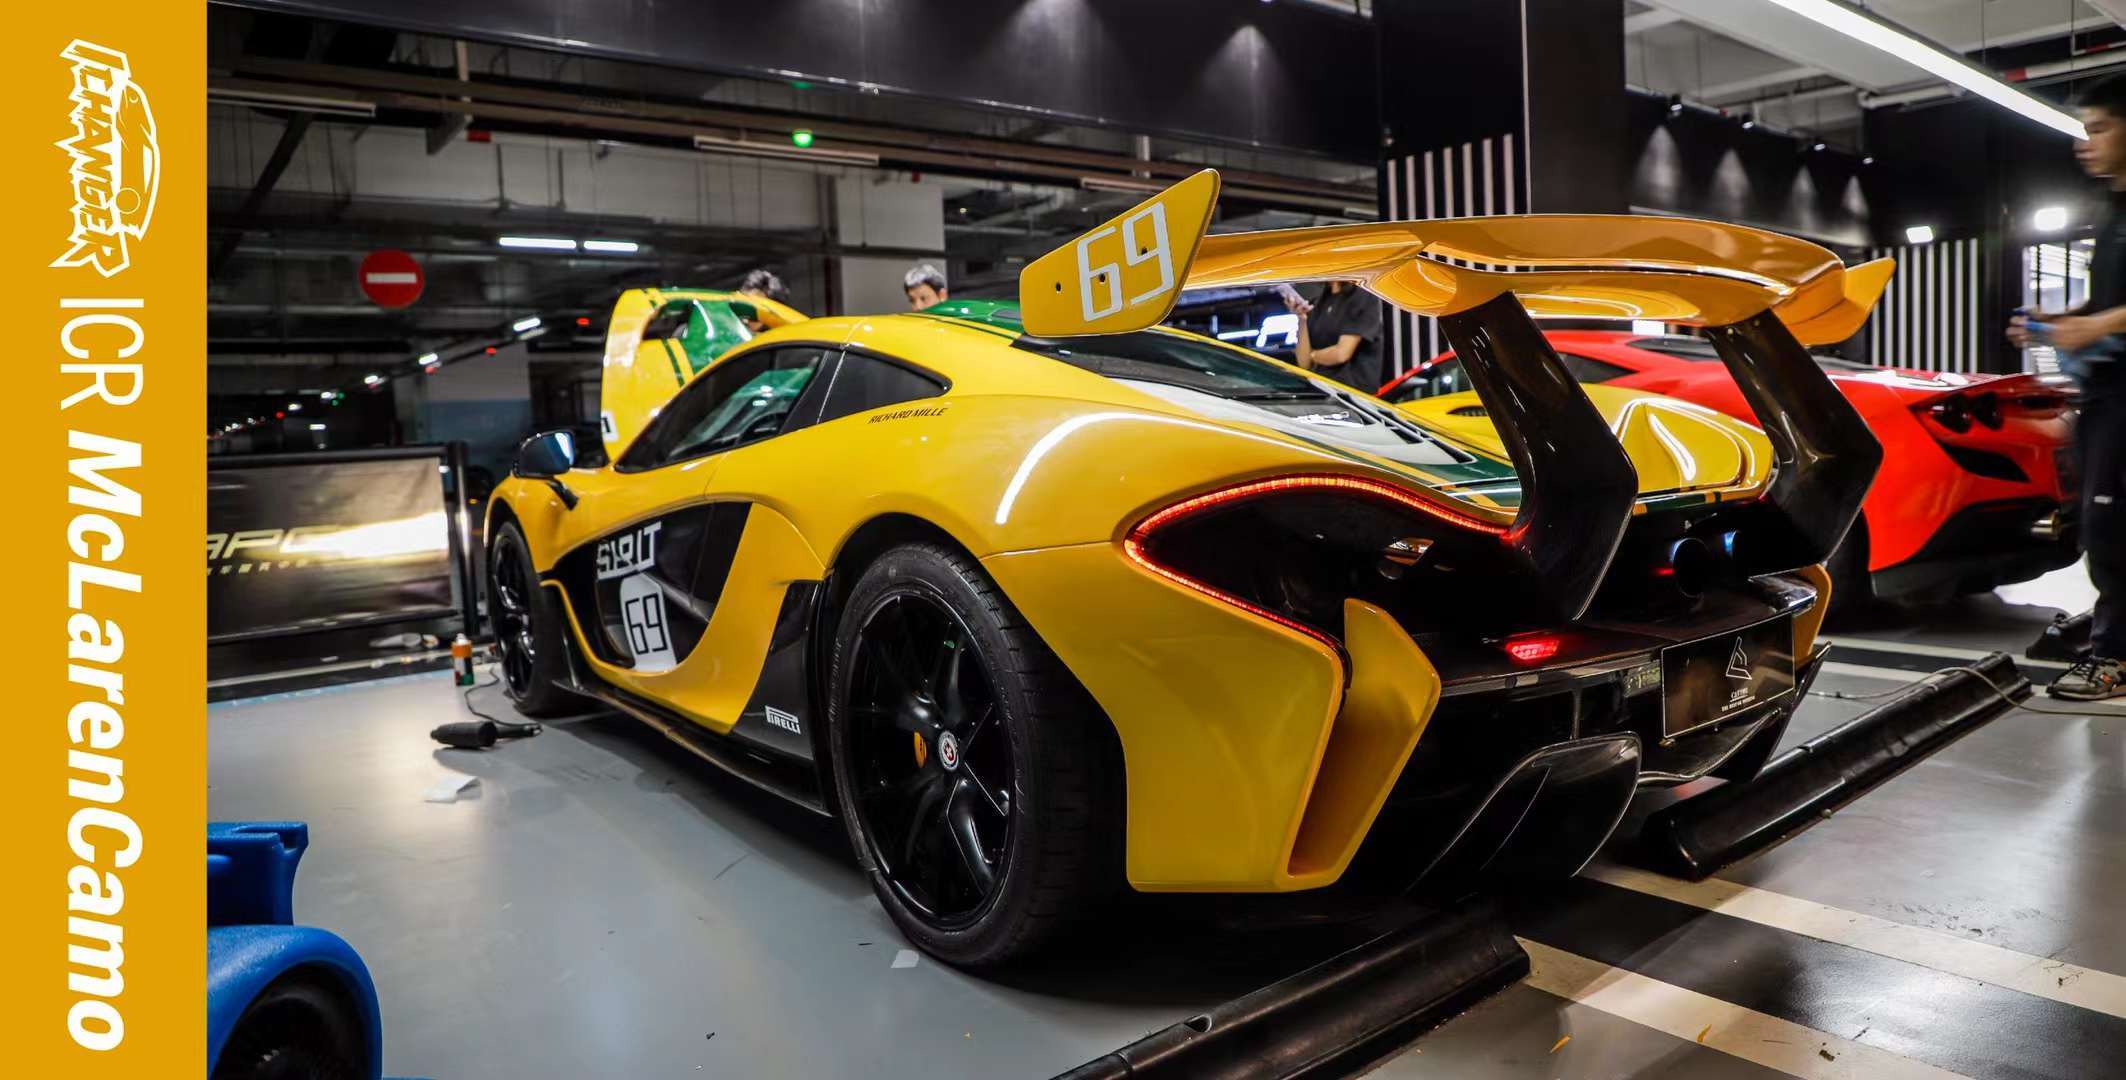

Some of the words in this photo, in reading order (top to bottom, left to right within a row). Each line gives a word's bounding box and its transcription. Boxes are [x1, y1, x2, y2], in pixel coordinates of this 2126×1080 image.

[1077, 201, 1174, 321] 69
[867, 409, 912, 424] RICHARD
[913, 407, 949, 417] MILLE
[625, 593, 668, 655] 69
[765, 705, 801, 735] PIRELLI
